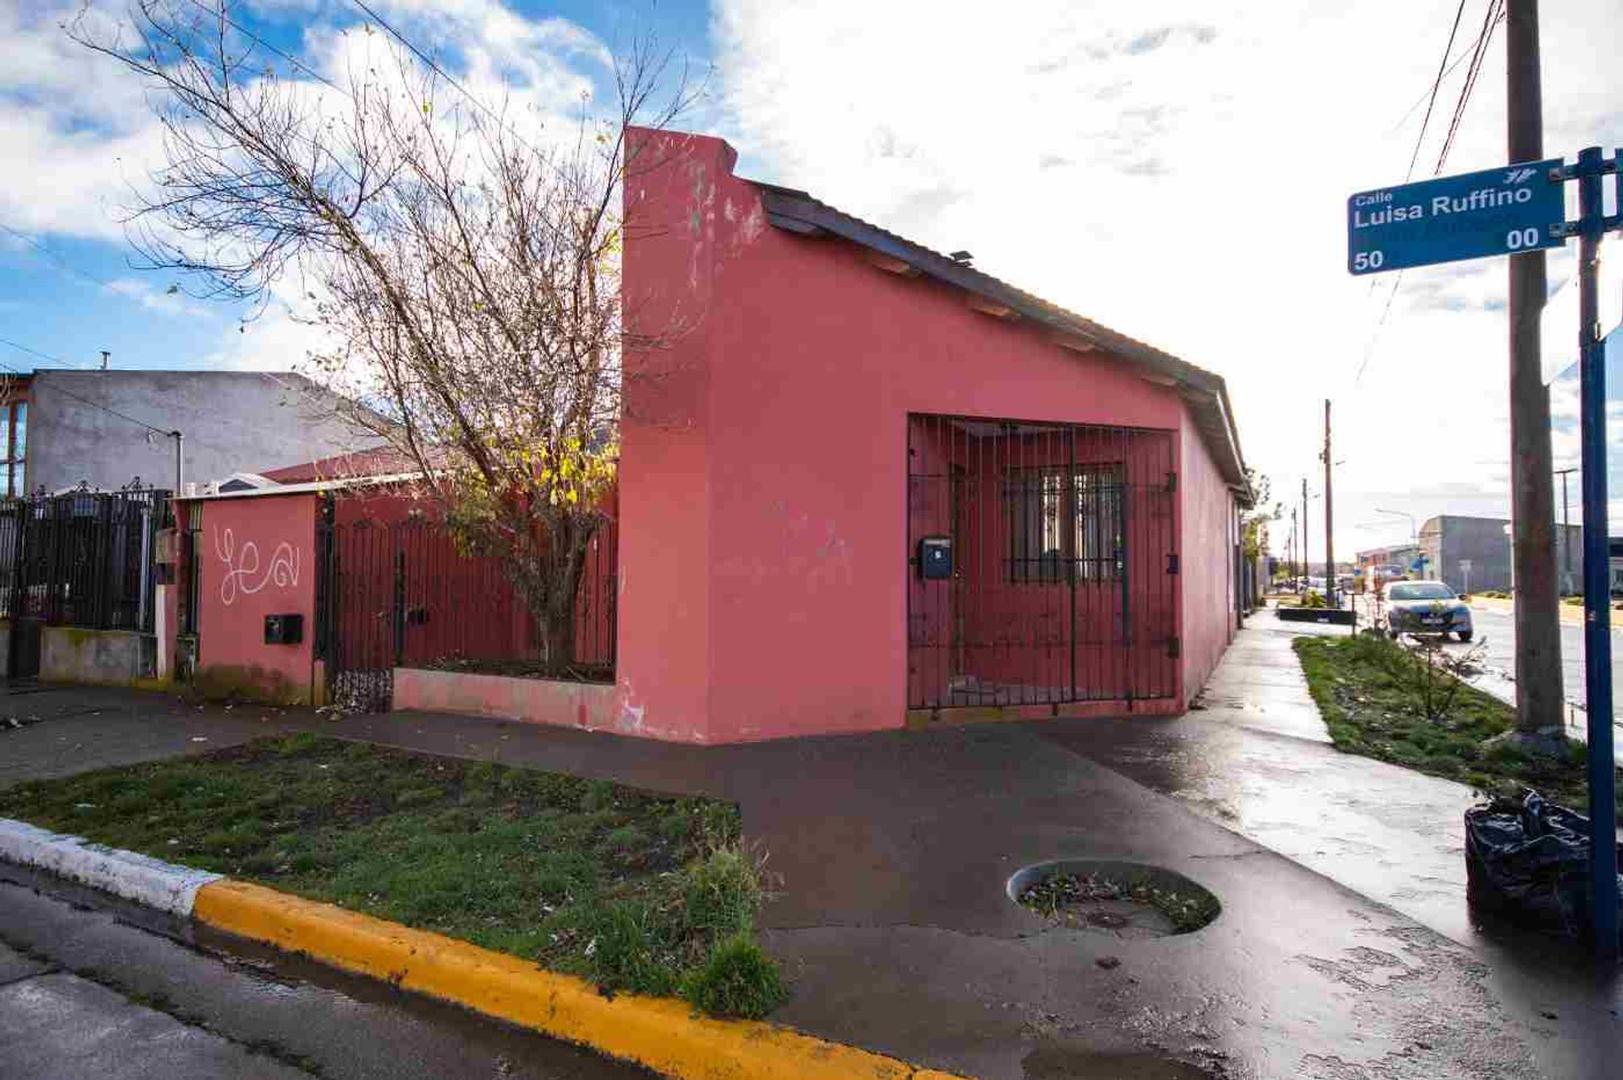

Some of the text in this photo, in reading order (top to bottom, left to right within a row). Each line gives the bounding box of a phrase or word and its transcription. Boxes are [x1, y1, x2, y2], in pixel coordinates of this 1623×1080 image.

[1354, 188, 1532, 228] Luisa Ruffino
[1355, 191, 1392, 206] Calle
[1507, 228, 1539, 249] 00
[1354, 250, 1383, 270] 50
